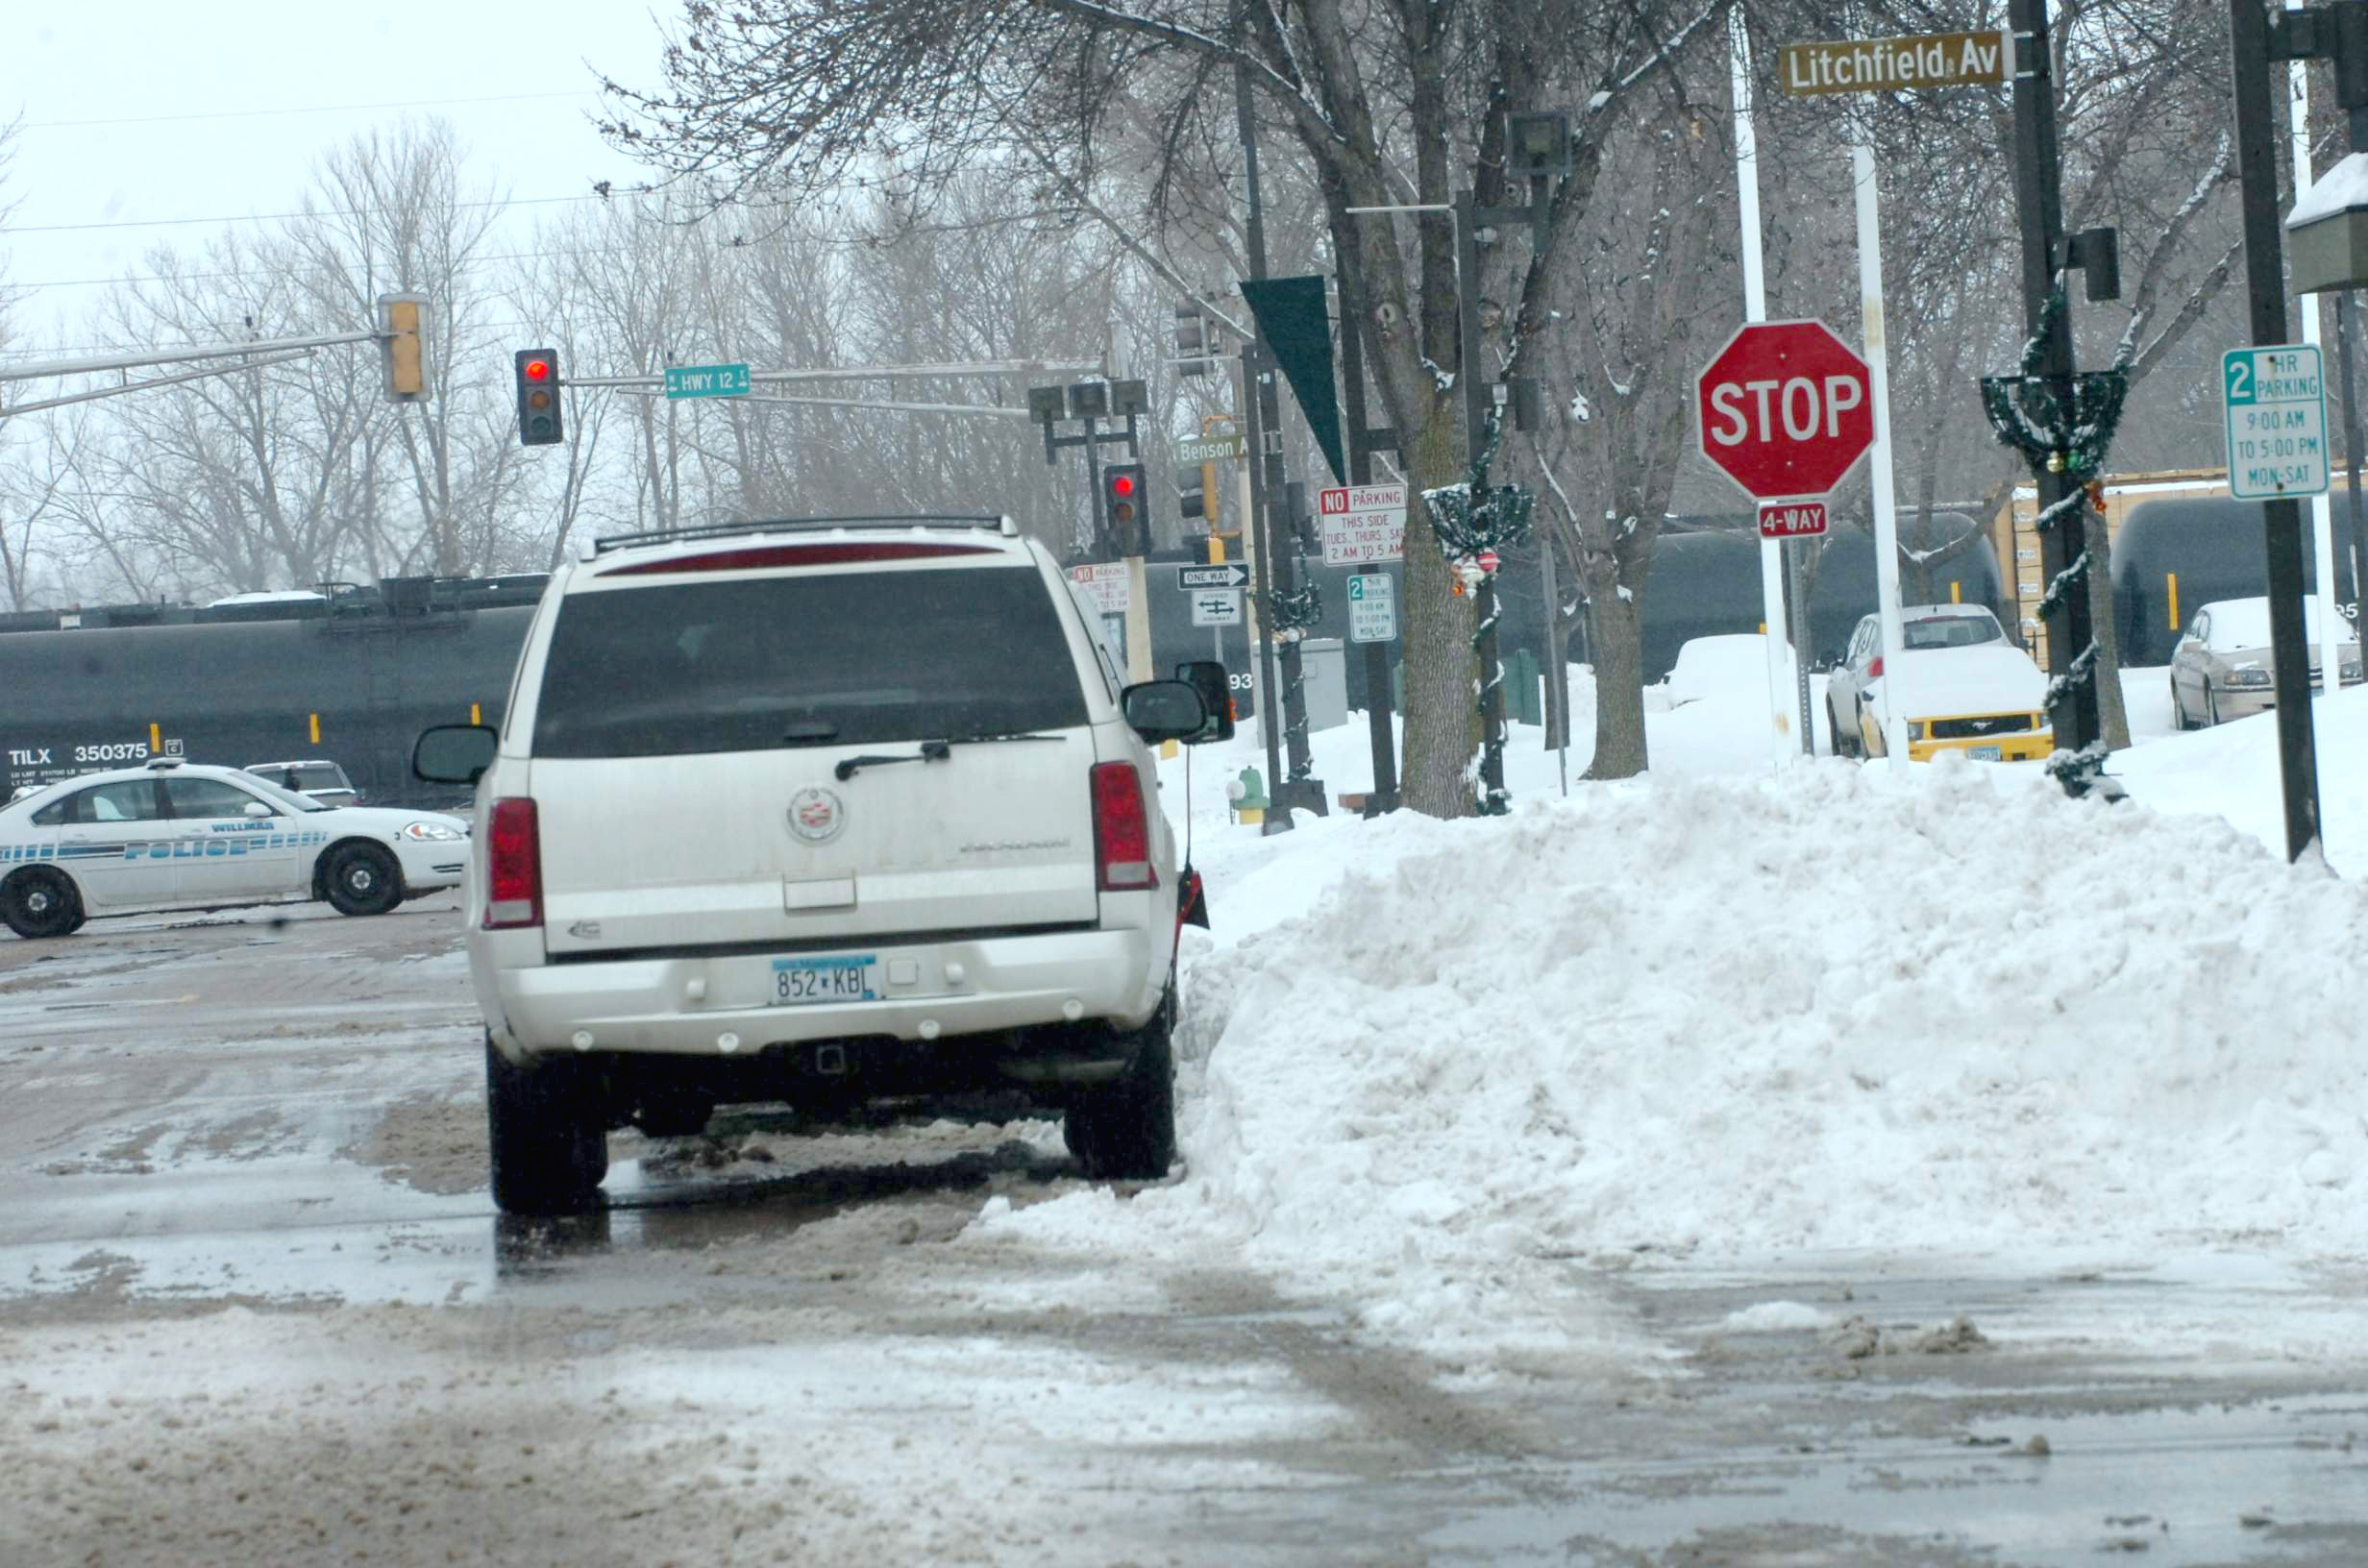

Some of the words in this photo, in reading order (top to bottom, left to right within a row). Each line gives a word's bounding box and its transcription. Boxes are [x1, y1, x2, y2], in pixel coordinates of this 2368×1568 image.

[1789, 41, 1944, 87] Litchfield
[1960, 38, 1998, 76] Av
[2274, 355, 2298, 373] HR
[681, 373, 713, 391] HWY
[719, 371, 734, 389] 12
[2229, 361, 2252, 398] 2
[2257, 377, 2318, 398] PARKING
[1711, 375, 1862, 446] STOP
[2247, 411, 2281, 430] 9:00
[2285, 410, 2306, 429] AM
[1180, 442, 1234, 461] Benson
[1240, 436, 1249, 454] A
[2238, 441, 2255, 459] TO
[2260, 438, 2294, 458] 5:00
[2299, 437, 2318, 455] PM
[2248, 464, 2309, 487] MON-SAT
[1324, 492, 1344, 512] NO
[1353, 491, 1400, 507] PARKING
[1341, 516, 1363, 528] THIS
[1368, 514, 1390, 527] SIDE
[1763, 508, 1822, 531] 4-WAY
[1331, 548, 1339, 559] 2
[1343, 547, 1358, 557] AM
[1362, 545, 1373, 556] TO
[1377, 544, 1384, 556] 5
[1187, 573, 1207, 583] ONE
[1210, 571, 1229, 581] WAY
[1351, 580, 1362, 598] 2
[1229, 673, 1253, 690] 93
[9, 748, 52, 766] TILX
[75, 743, 148, 762] 350375
[211, 821, 275, 833] WILLMAR
[123, 839, 249, 860] POLICE
[777, 969, 817, 997] 852
[833, 967, 874, 994] KBL
